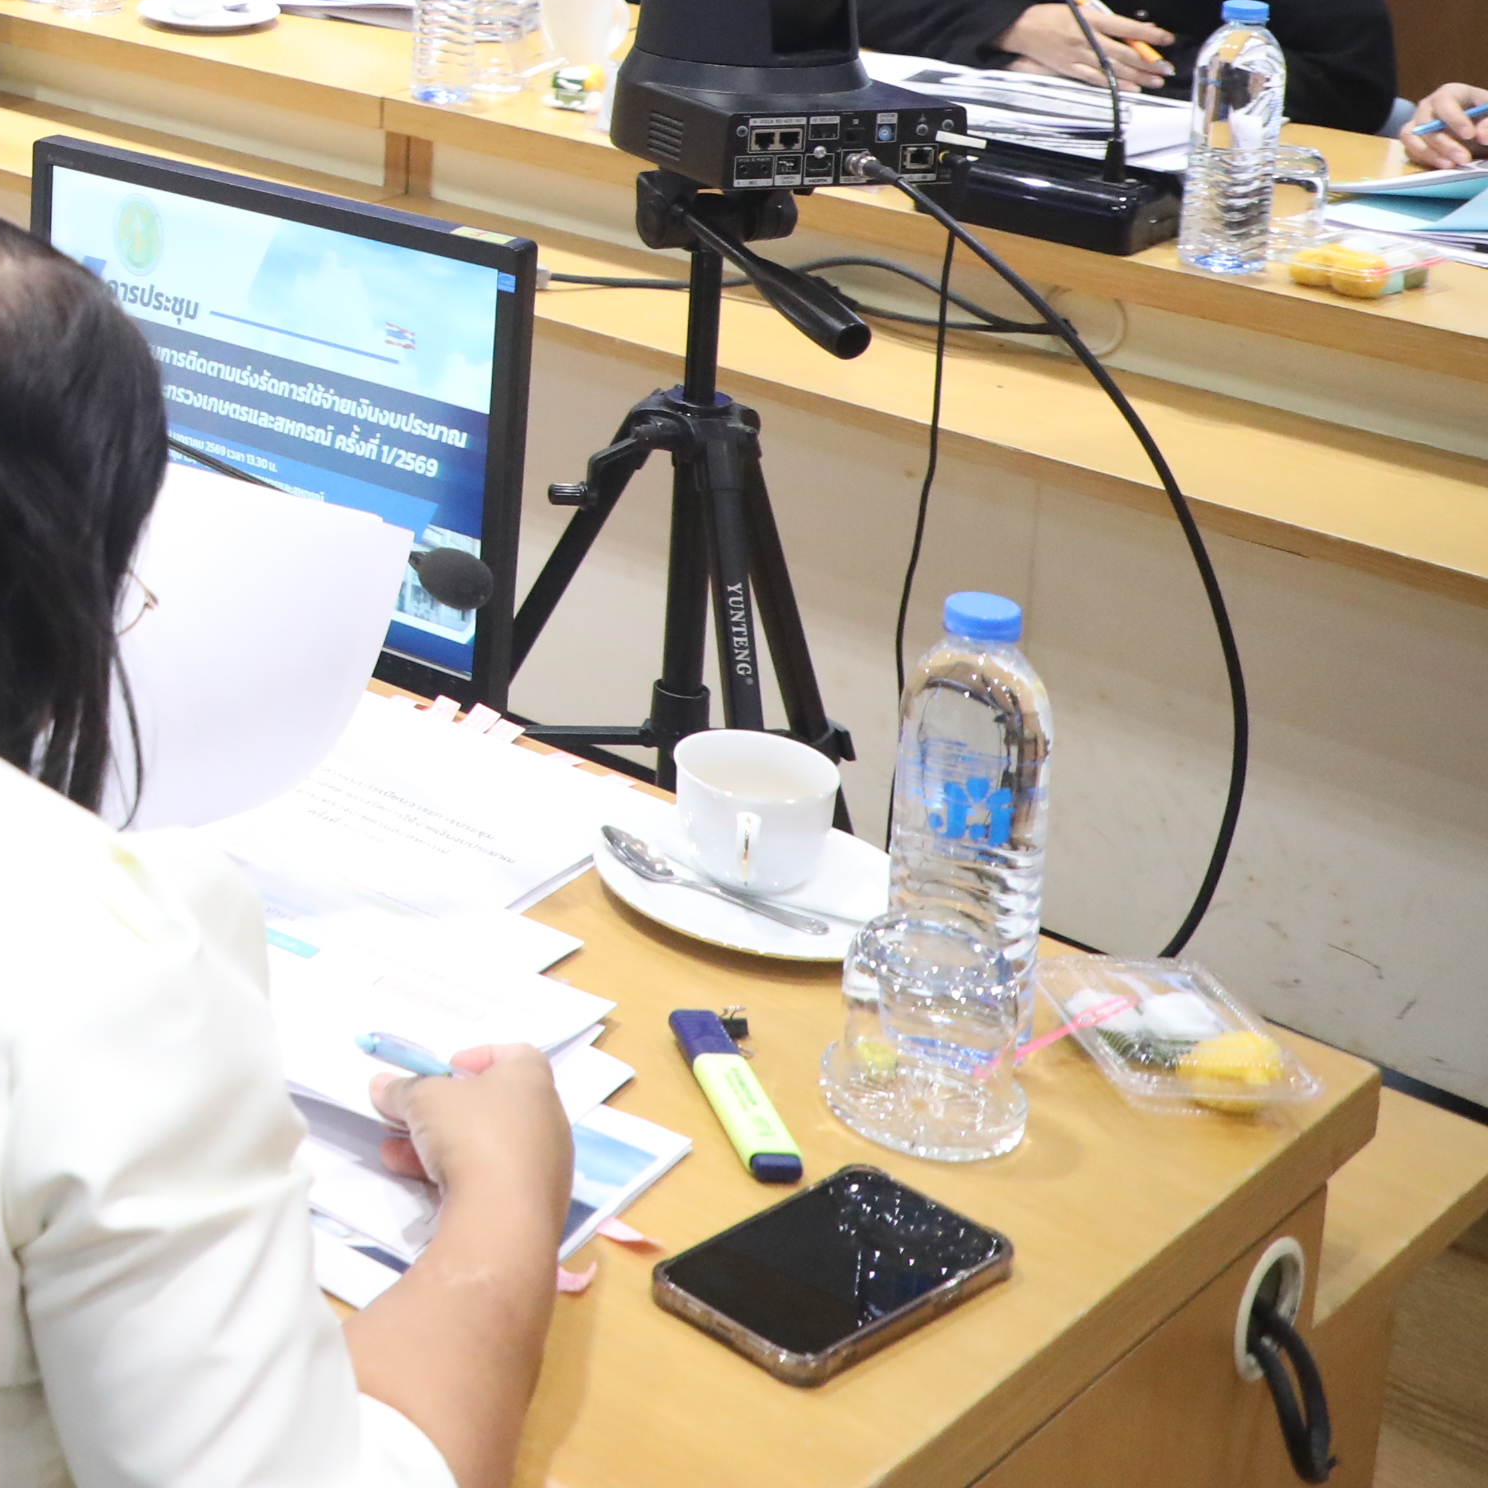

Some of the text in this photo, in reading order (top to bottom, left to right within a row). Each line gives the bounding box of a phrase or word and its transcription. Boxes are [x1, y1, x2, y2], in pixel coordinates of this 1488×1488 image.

[107, 278, 200, 325] การประชุม
[152, 344, 468, 449] มการติดตามเร่งรัดการใช้จ่ายเงินงบประมาณ
[205, 440, 226, 457] 2569
[334, 424, 381, 460] ครั้งที่
[380, 444, 439, 478] 1/2569
[726, 582, 752, 677] YUNTENG
